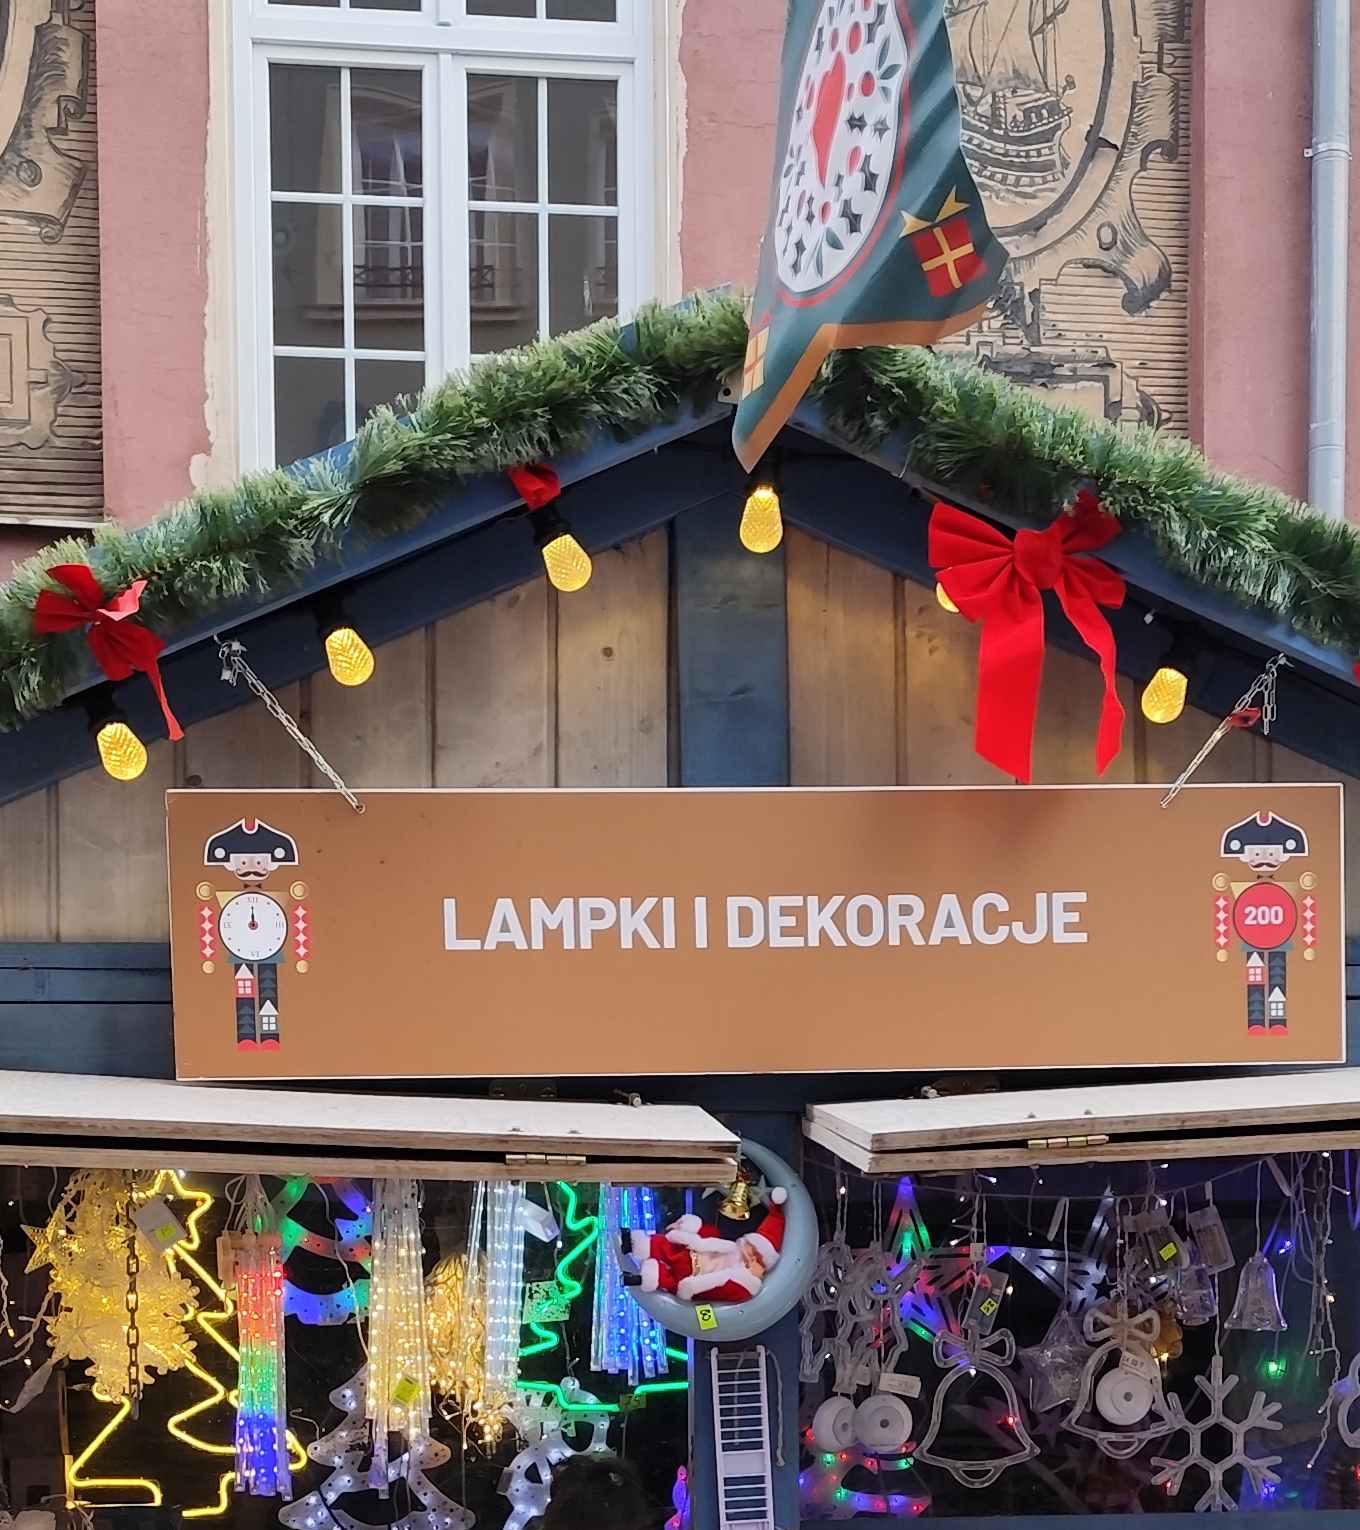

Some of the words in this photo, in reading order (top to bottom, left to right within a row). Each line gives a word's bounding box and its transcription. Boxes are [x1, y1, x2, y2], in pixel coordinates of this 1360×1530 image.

[442, 896, 676, 951] LAMPKI
[695, 895, 709, 949] I
[726, 891, 1089, 949] DEKORACJE
[1244, 905, 1284, 926] 200
